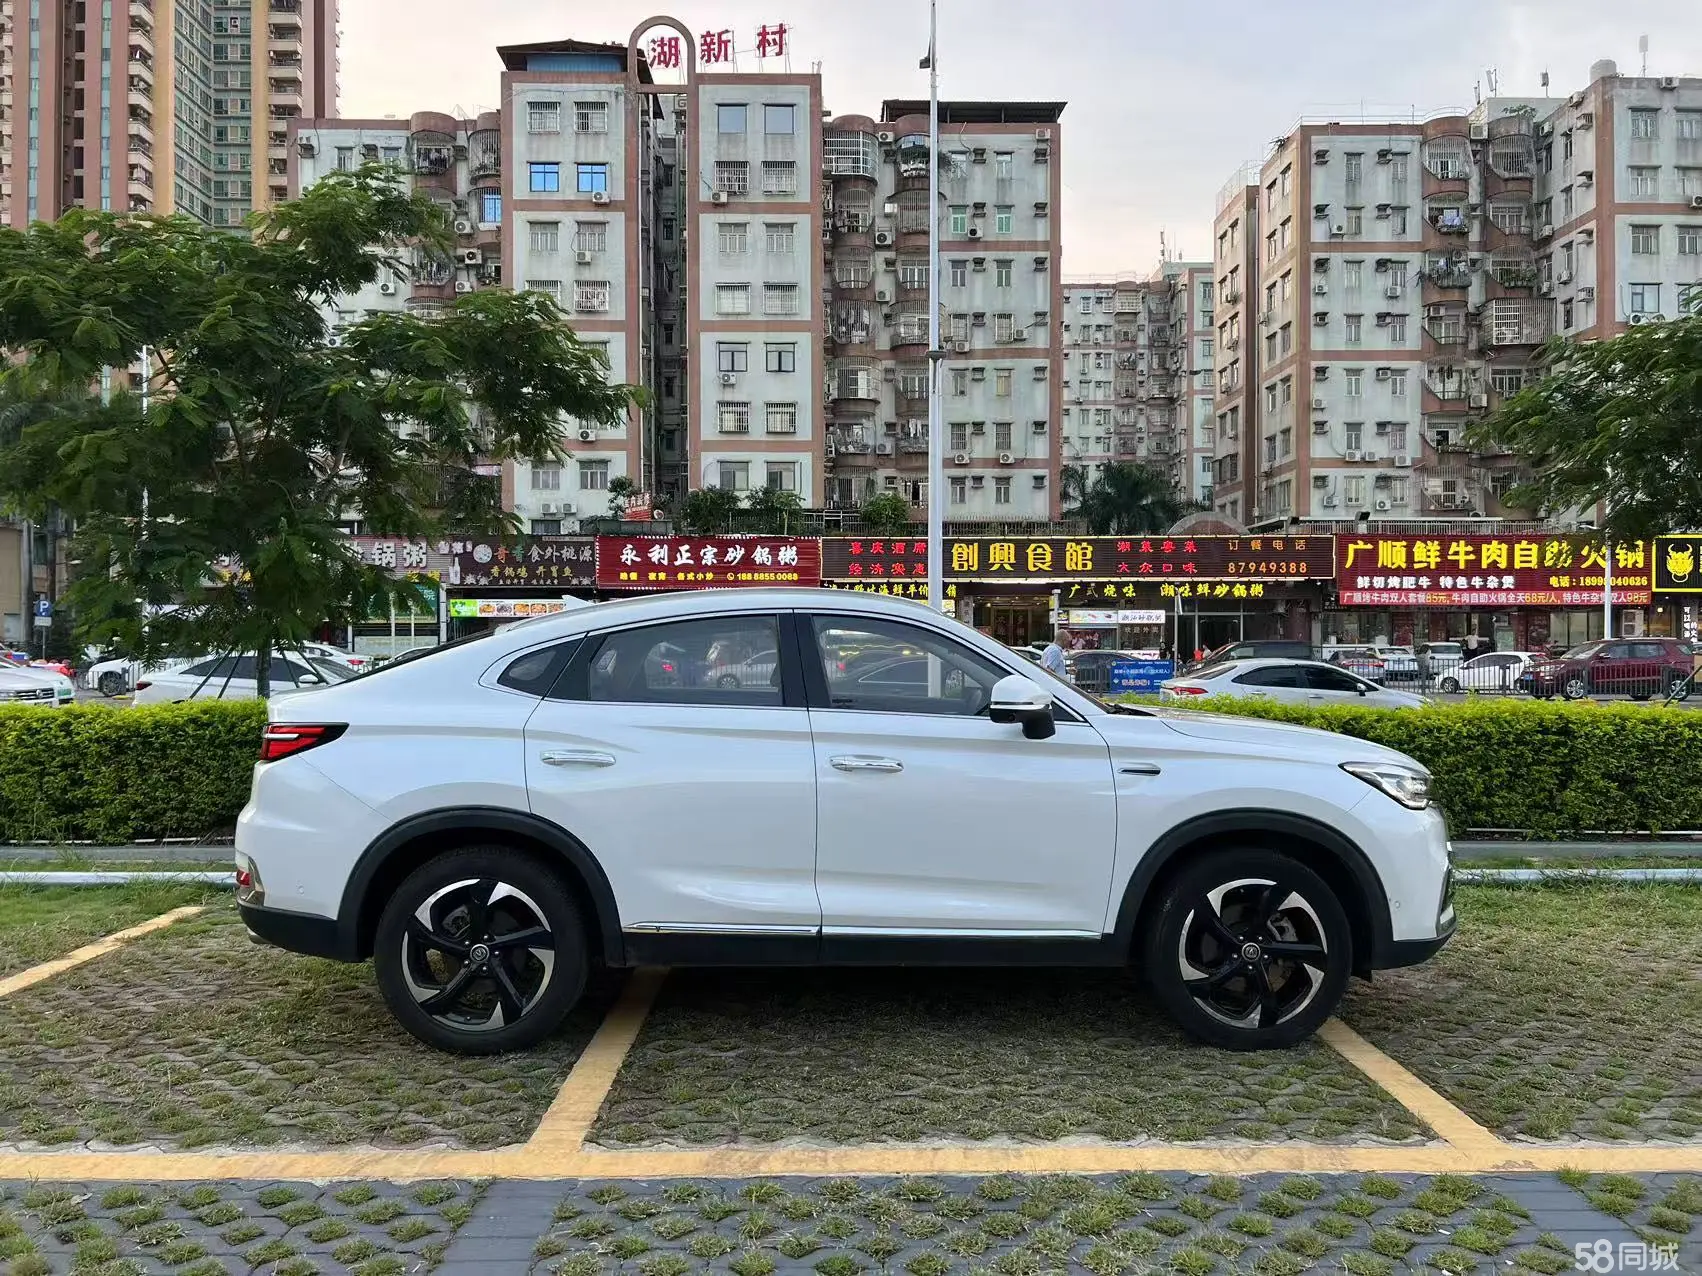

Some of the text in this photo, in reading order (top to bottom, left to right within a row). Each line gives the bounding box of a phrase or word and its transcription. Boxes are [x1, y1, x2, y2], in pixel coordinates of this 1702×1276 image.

[848, 541, 928, 555] 喜庆酒席
[1116, 540, 1199, 553] 潮菜粤菜
[1228, 539, 1307, 551] 订餐电话
[619, 544, 799, 566] 永利正宗砂锅粥
[951, 542, 1094, 572] 創興食館
[1344, 539, 1645, 569] 广顺鲜牛肉自助火锅
[848, 563, 928, 576] 经济实惠
[1116, 562, 1199, 574] 大众口味
[1228, 562, 1307, 574] 87949388
[1356, 576, 1432, 589] 鲜切烤肥牛
[1439, 576, 1515, 589] 特色牛杂煲
